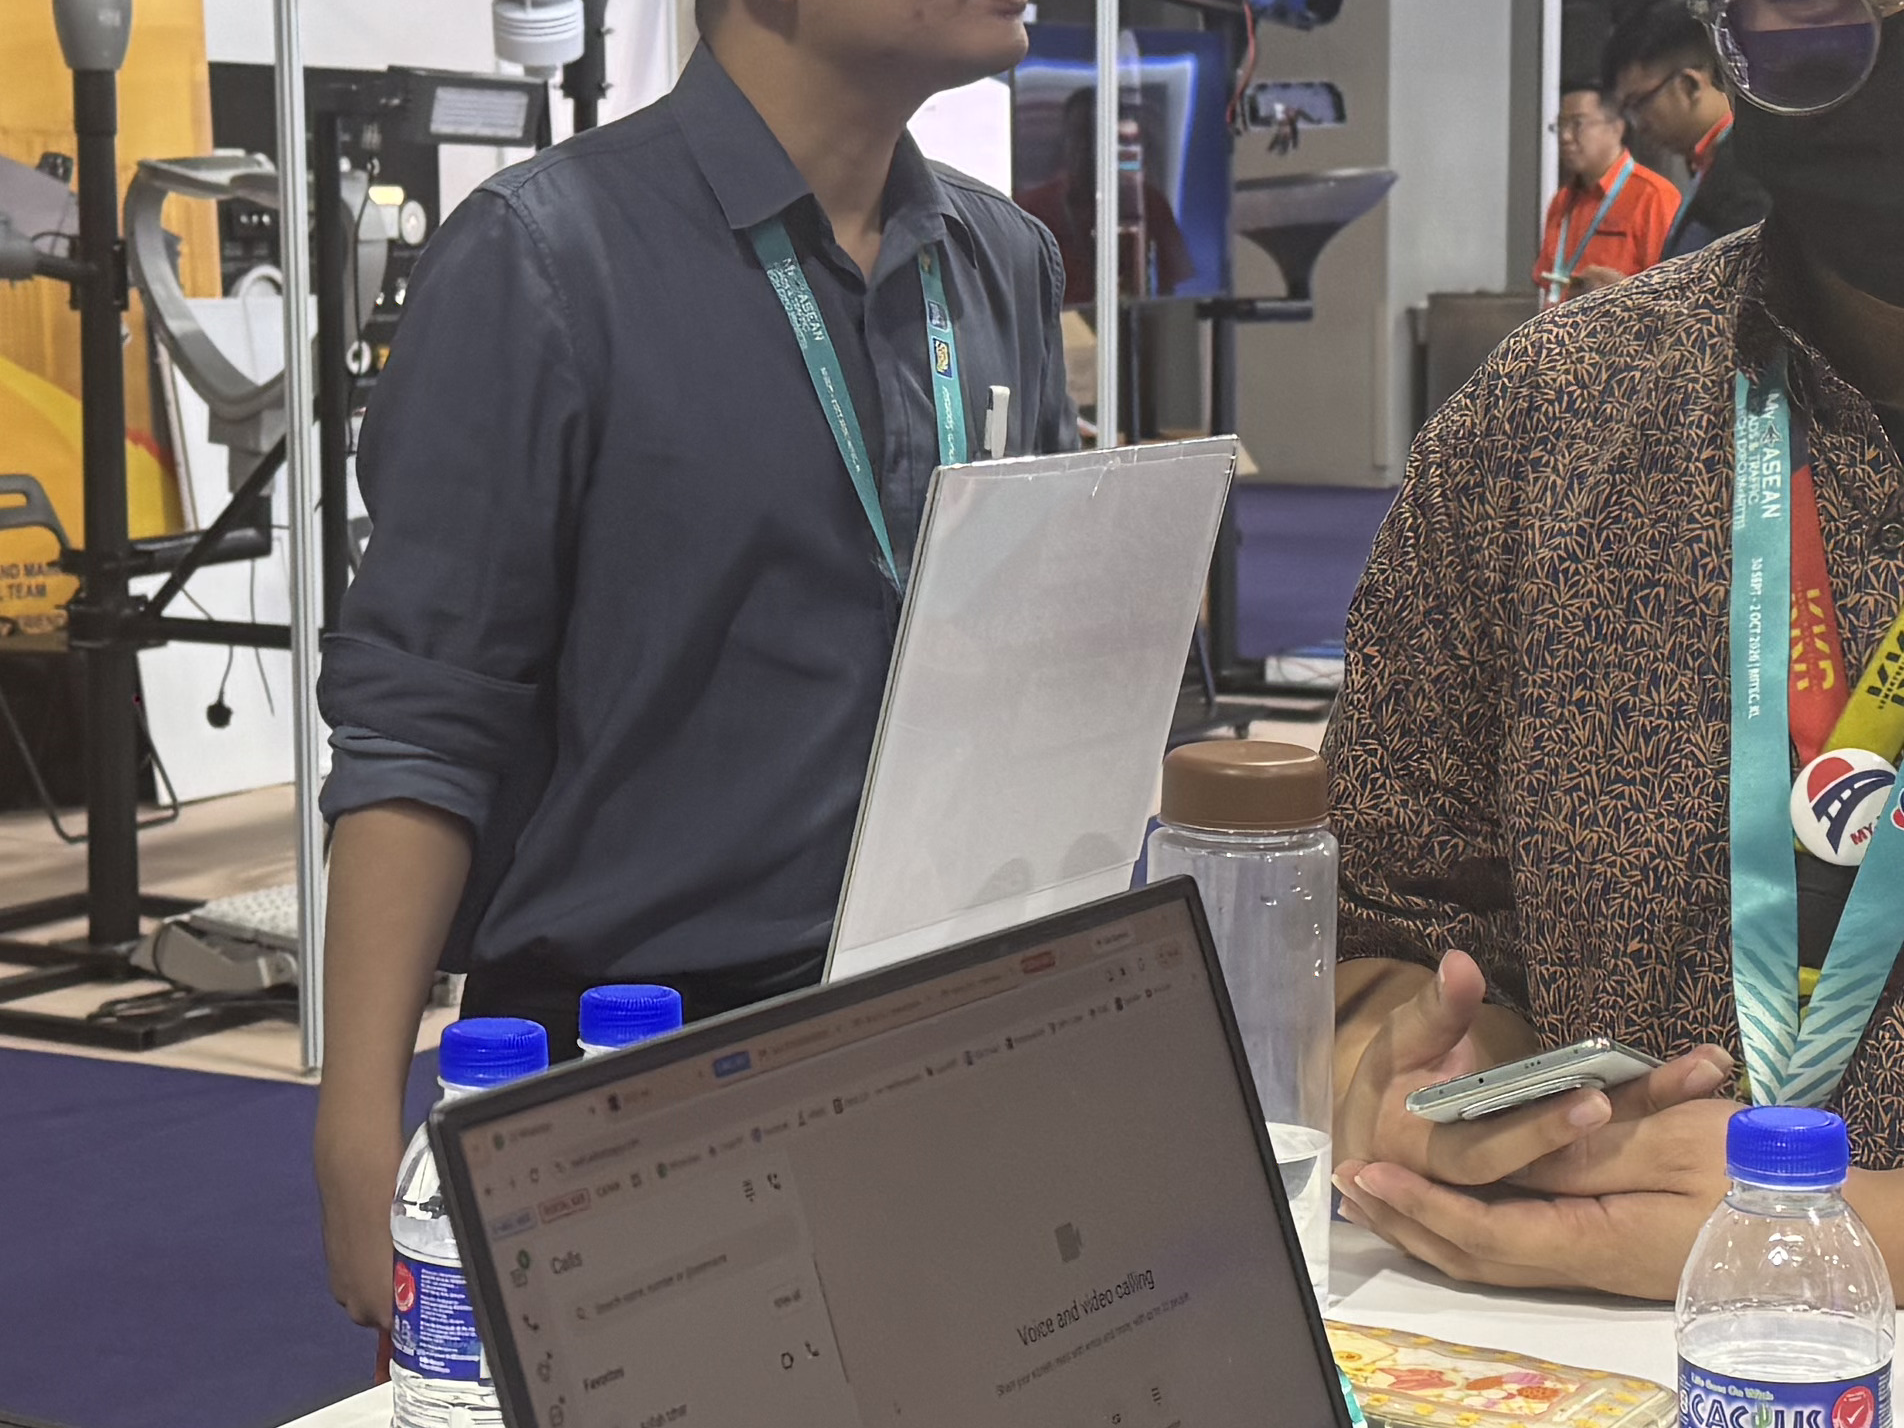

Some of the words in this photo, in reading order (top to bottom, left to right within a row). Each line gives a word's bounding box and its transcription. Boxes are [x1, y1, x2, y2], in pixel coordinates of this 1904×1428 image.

[1760, 447, 1782, 519] ASEAN
[1748, 613, 1760, 633] OCT
[1016, 1311, 1056, 1350] Voice
[1054, 1299, 1081, 1332] and
[1079, 1283, 1115, 1319] video
[1112, 1263, 1157, 1306] calling
